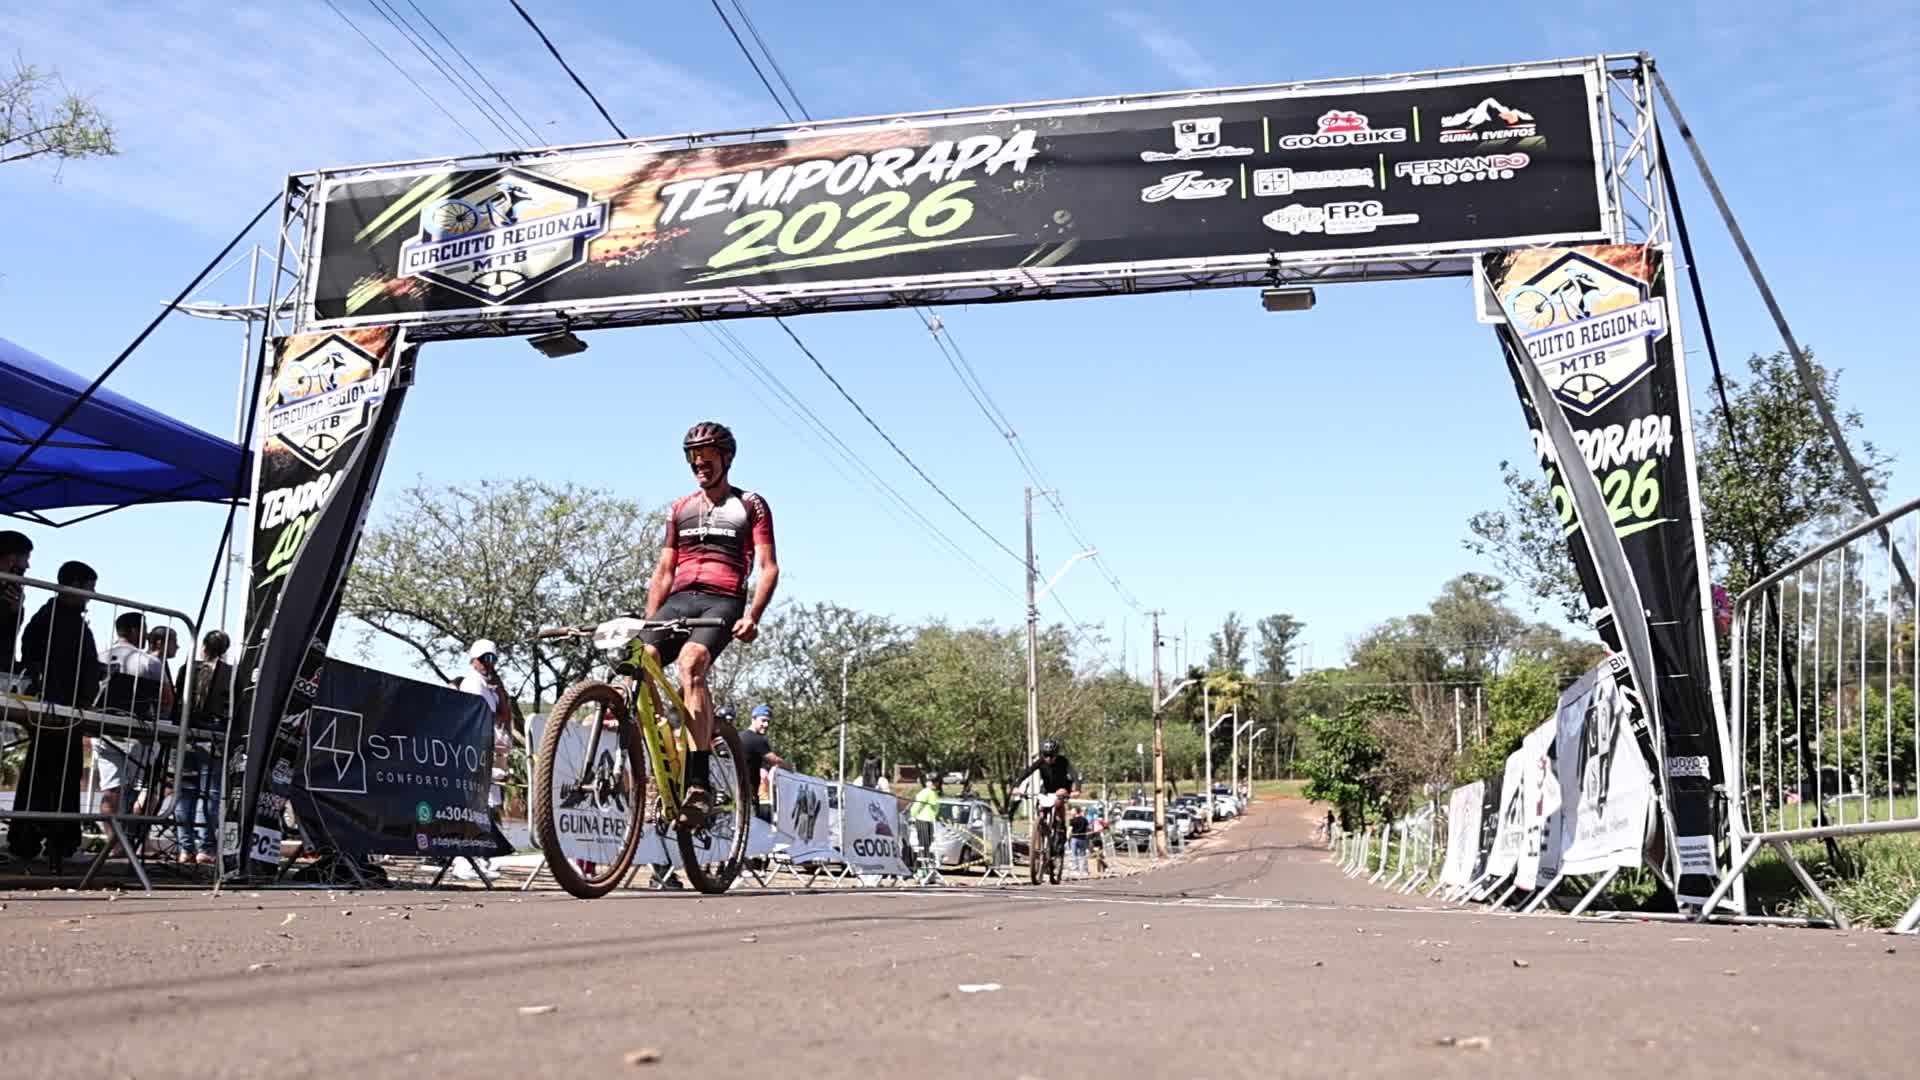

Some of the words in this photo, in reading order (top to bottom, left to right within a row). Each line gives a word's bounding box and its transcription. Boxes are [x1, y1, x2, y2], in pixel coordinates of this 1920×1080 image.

[1283, 135, 1347, 147] GOOD
[1354, 130, 1403, 142] BIKE
[1440, 132, 1478, 143] GUINA
[1482, 128, 1536, 140] EVENTOS
[1397, 154, 1527, 174] FERNANDO
[661, 129, 1039, 225] TEMPORADA
[1328, 203, 1379, 219] FPC
[706, 180, 976, 269] 2026
[409, 235, 495, 268] CIRCUITO
[502, 214, 598, 248] REGIONAL
[472, 250, 529, 273] MTB
[1560, 351, 1607, 375] MTB
[307, 415, 340, 434] MTB
[1597, 458, 1660, 522] 26
[376, 771, 449, 787] CONFORTO
[560, 814, 600, 835] GUINA
[853, 839, 890, 857] GOOD
